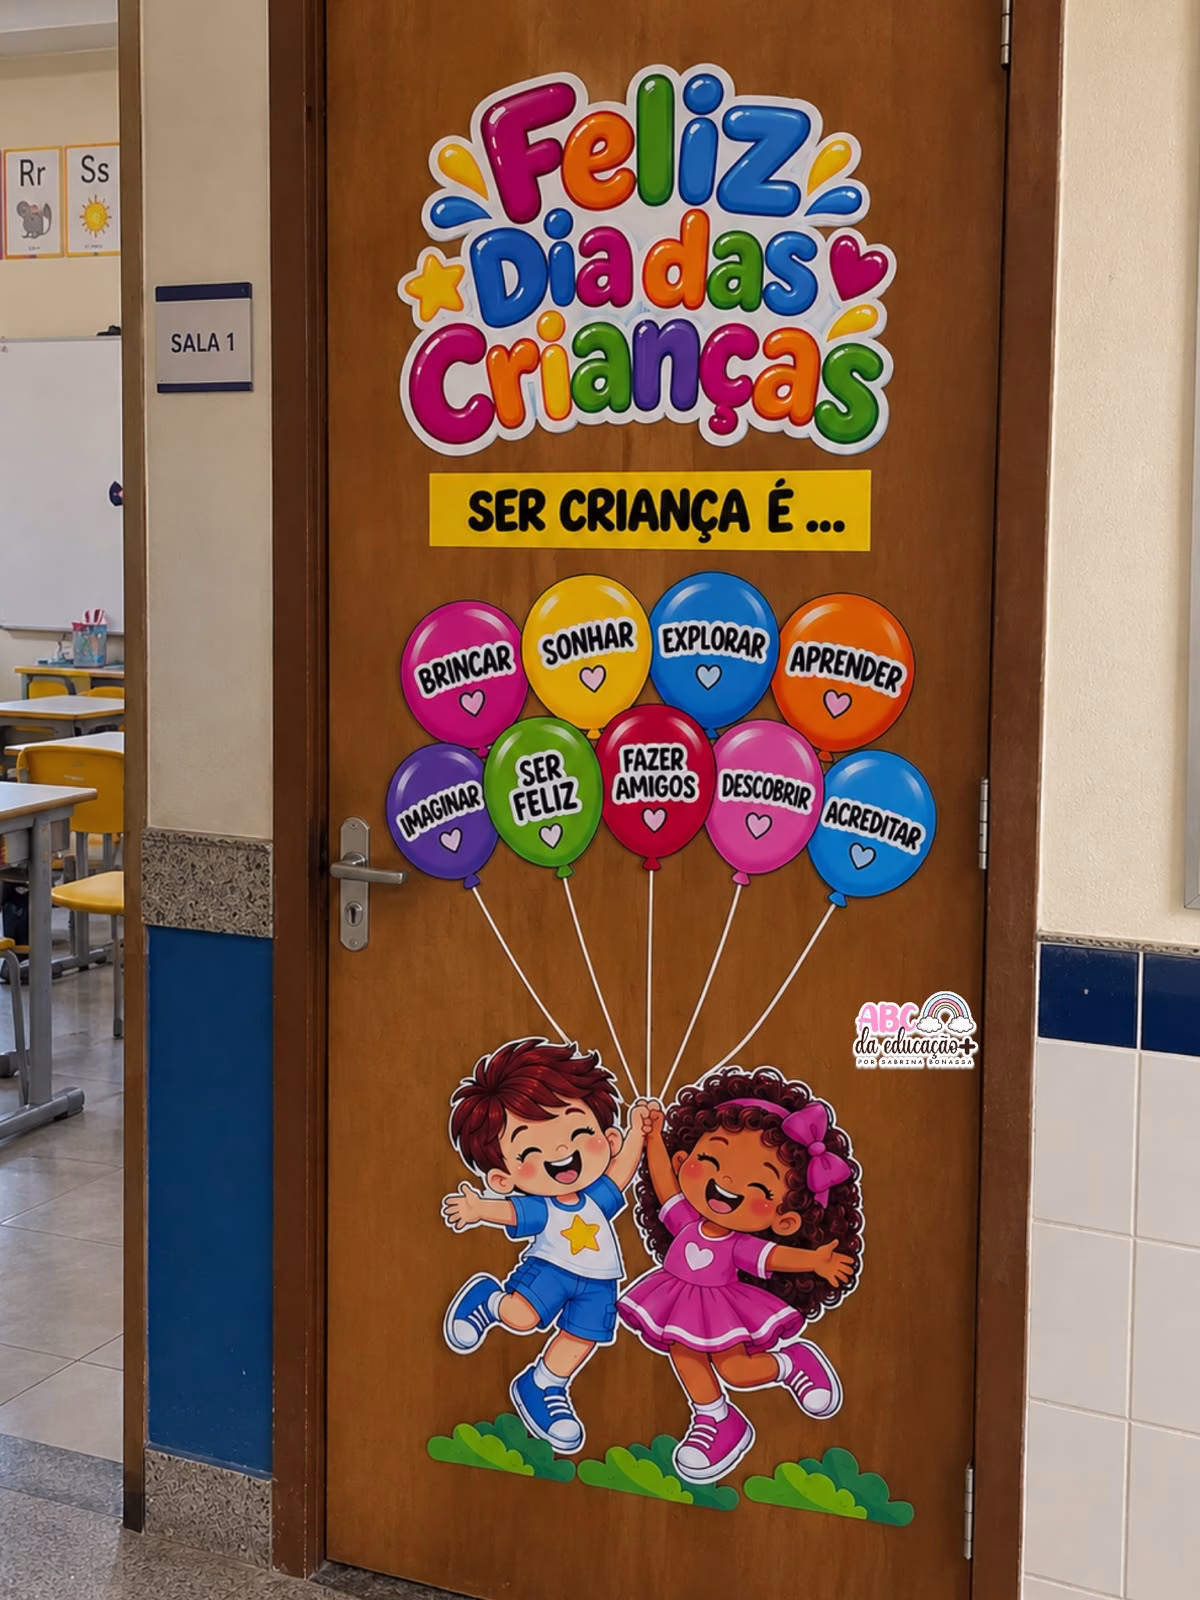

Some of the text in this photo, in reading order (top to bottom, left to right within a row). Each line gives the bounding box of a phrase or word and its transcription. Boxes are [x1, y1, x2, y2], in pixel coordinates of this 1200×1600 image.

[81, 154, 110, 183] Ss
[481, 73, 811, 224] Feliz
[20, 159, 46, 186] Rr
[469, 207, 818, 328] Dia das
[171, 332, 235, 353] SALA 1
[409, 310, 884, 444] Crianças
[468, 489, 546, 533] SER
[559, 488, 750, 543] CRIANÇA
[767, 478, 794, 533] É
[541, 621, 634, 665] SONHAR
[662, 625, 766, 659] EXPLORAR
[418, 644, 513, 693] BRINCAR
[789, 645, 902, 693] APRENDER
[519, 753, 562, 786] SER
[622, 747, 684, 772] FAZER
[513, 782, 577, 821] FELIZ
[615, 774, 697, 799] AMIGOS
[721, 773, 812, 810] DESCOBRIR
[400, 784, 480, 837] IMAGINAR
[824, 799, 922, 850] ACREDITAR
